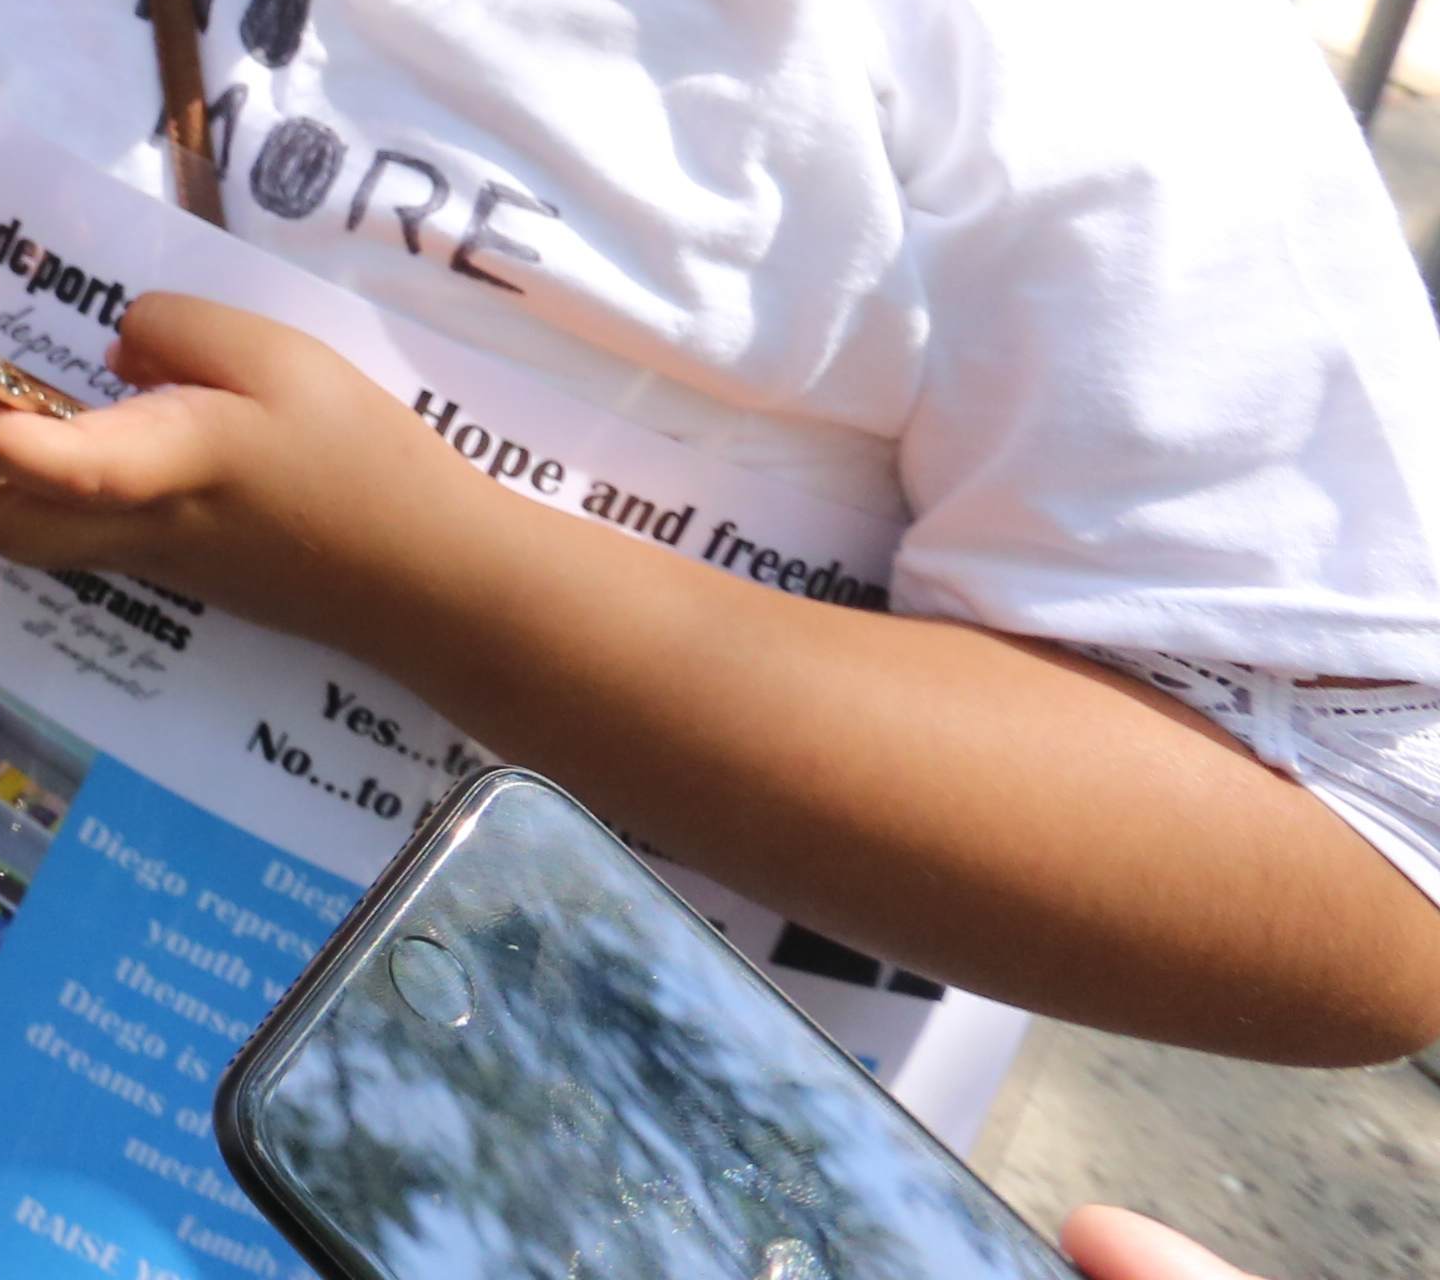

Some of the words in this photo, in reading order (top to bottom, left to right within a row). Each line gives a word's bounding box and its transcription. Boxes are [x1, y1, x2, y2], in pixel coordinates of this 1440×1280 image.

[413, 388, 567, 497] Hope
[580, 477, 695, 547] and
[78, 814, 190, 899] Diego
[195, 885, 319, 964] repres
[261, 858, 354, 926] Dieg
[114, 956, 255, 1041] themse
[145, 918, 253, 991] youth
[25, 1022, 167, 1119] dreams
[56, 979, 168, 1061] Diego
[176, 1044, 210, 1083] is
